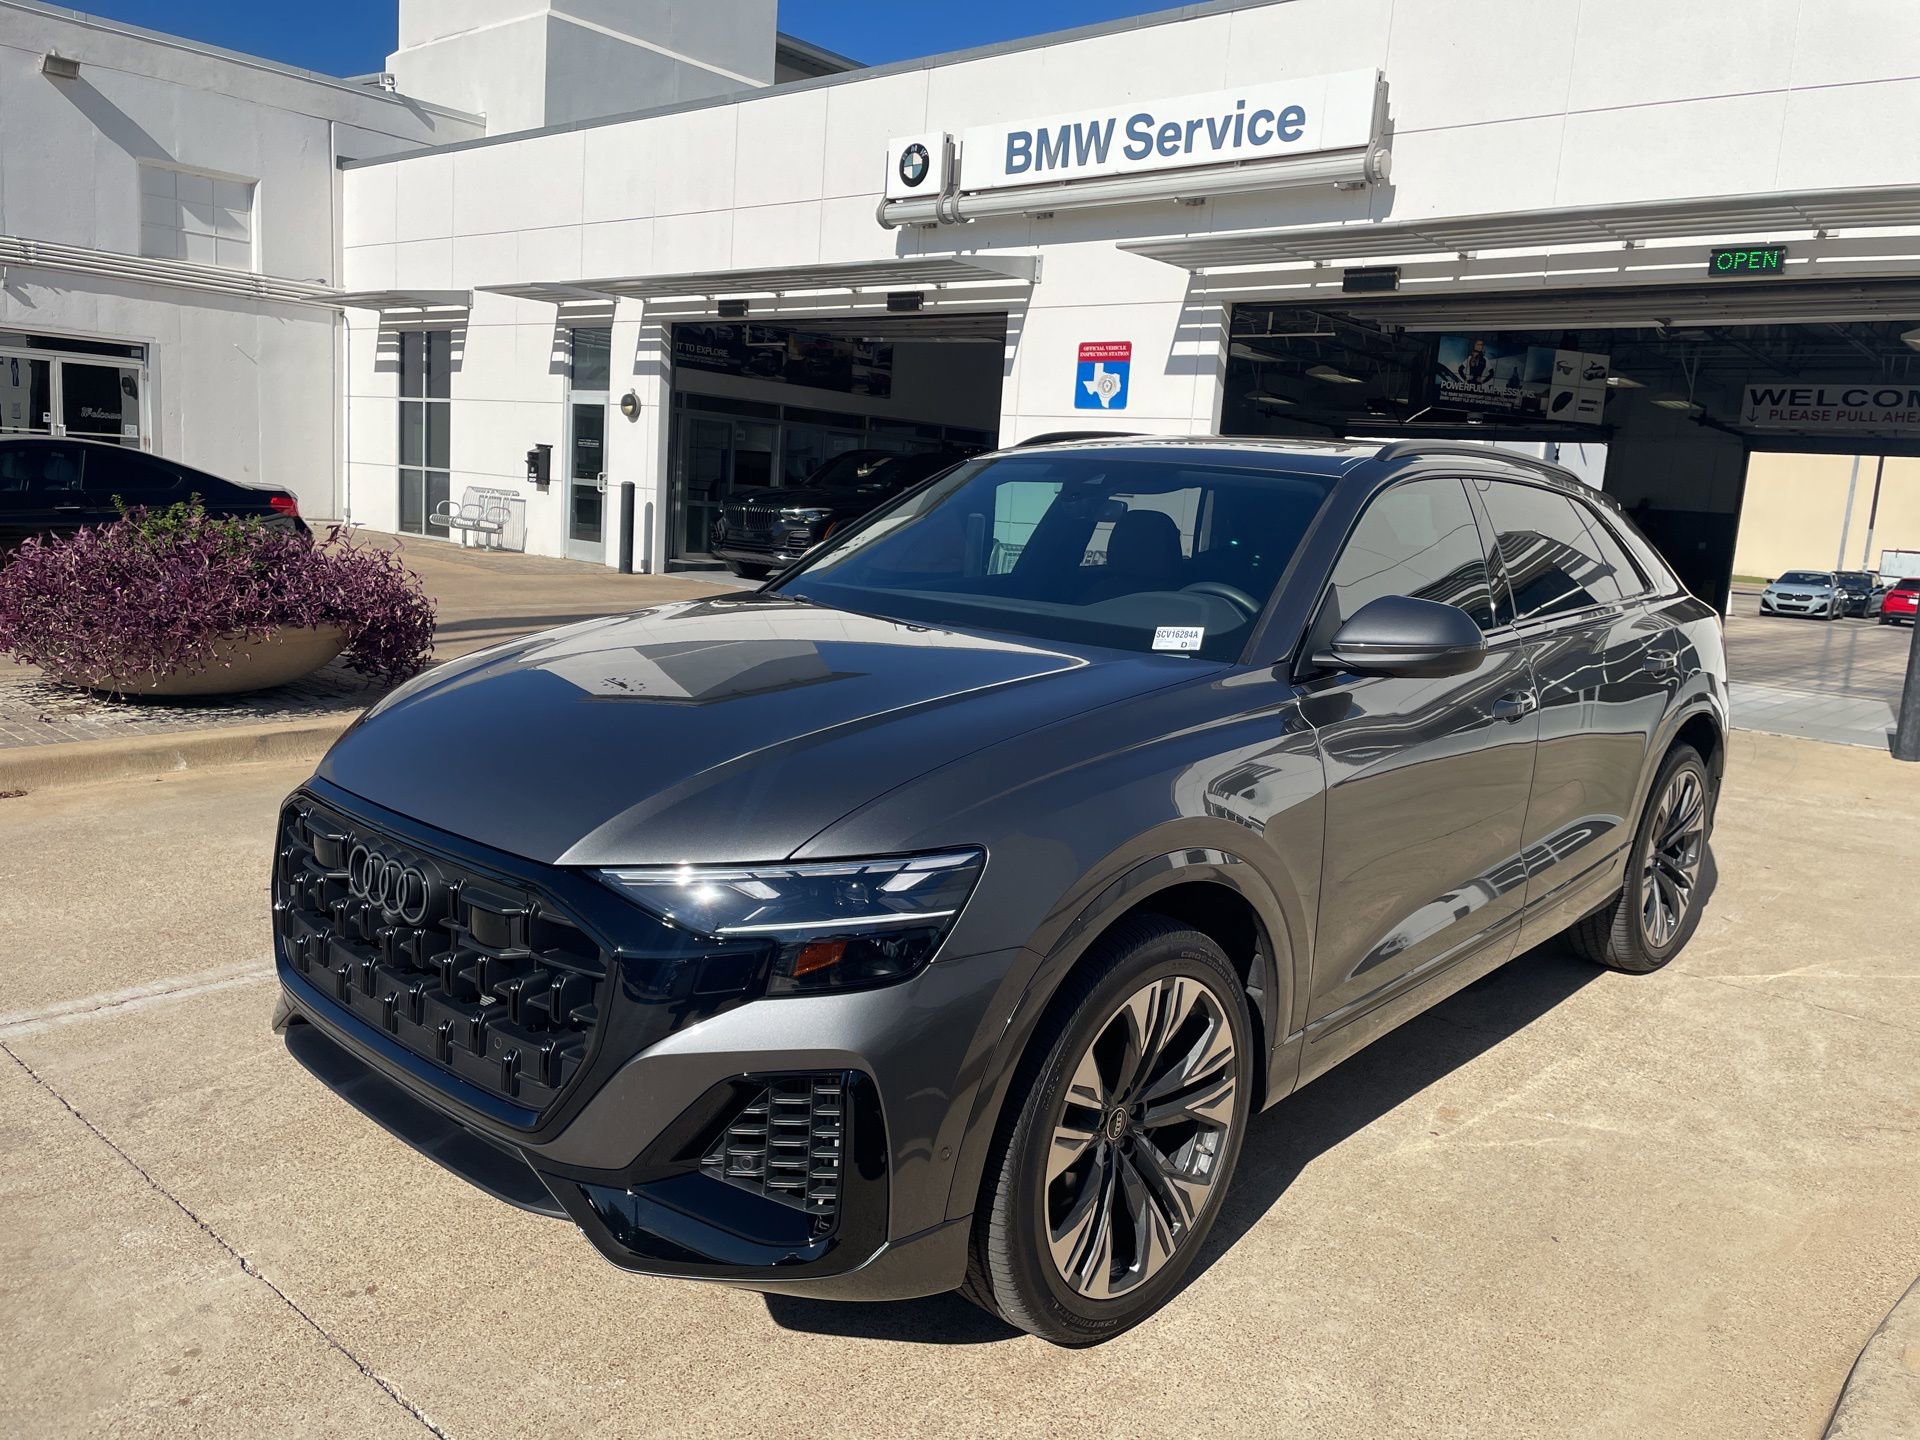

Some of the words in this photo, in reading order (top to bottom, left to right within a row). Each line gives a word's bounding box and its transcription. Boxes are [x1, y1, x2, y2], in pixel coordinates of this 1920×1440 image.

[1005, 118, 1116, 175] BMW
[1123, 100, 1306, 161] Service
[1716, 250, 1778, 270] OPEN
[1440, 380, 1482, 392] POWERFUL
[1768, 409, 1832, 423] PLEASE
[1835, 410, 1878, 423] PULL
[1156, 630, 1198, 638] SCV16284A
